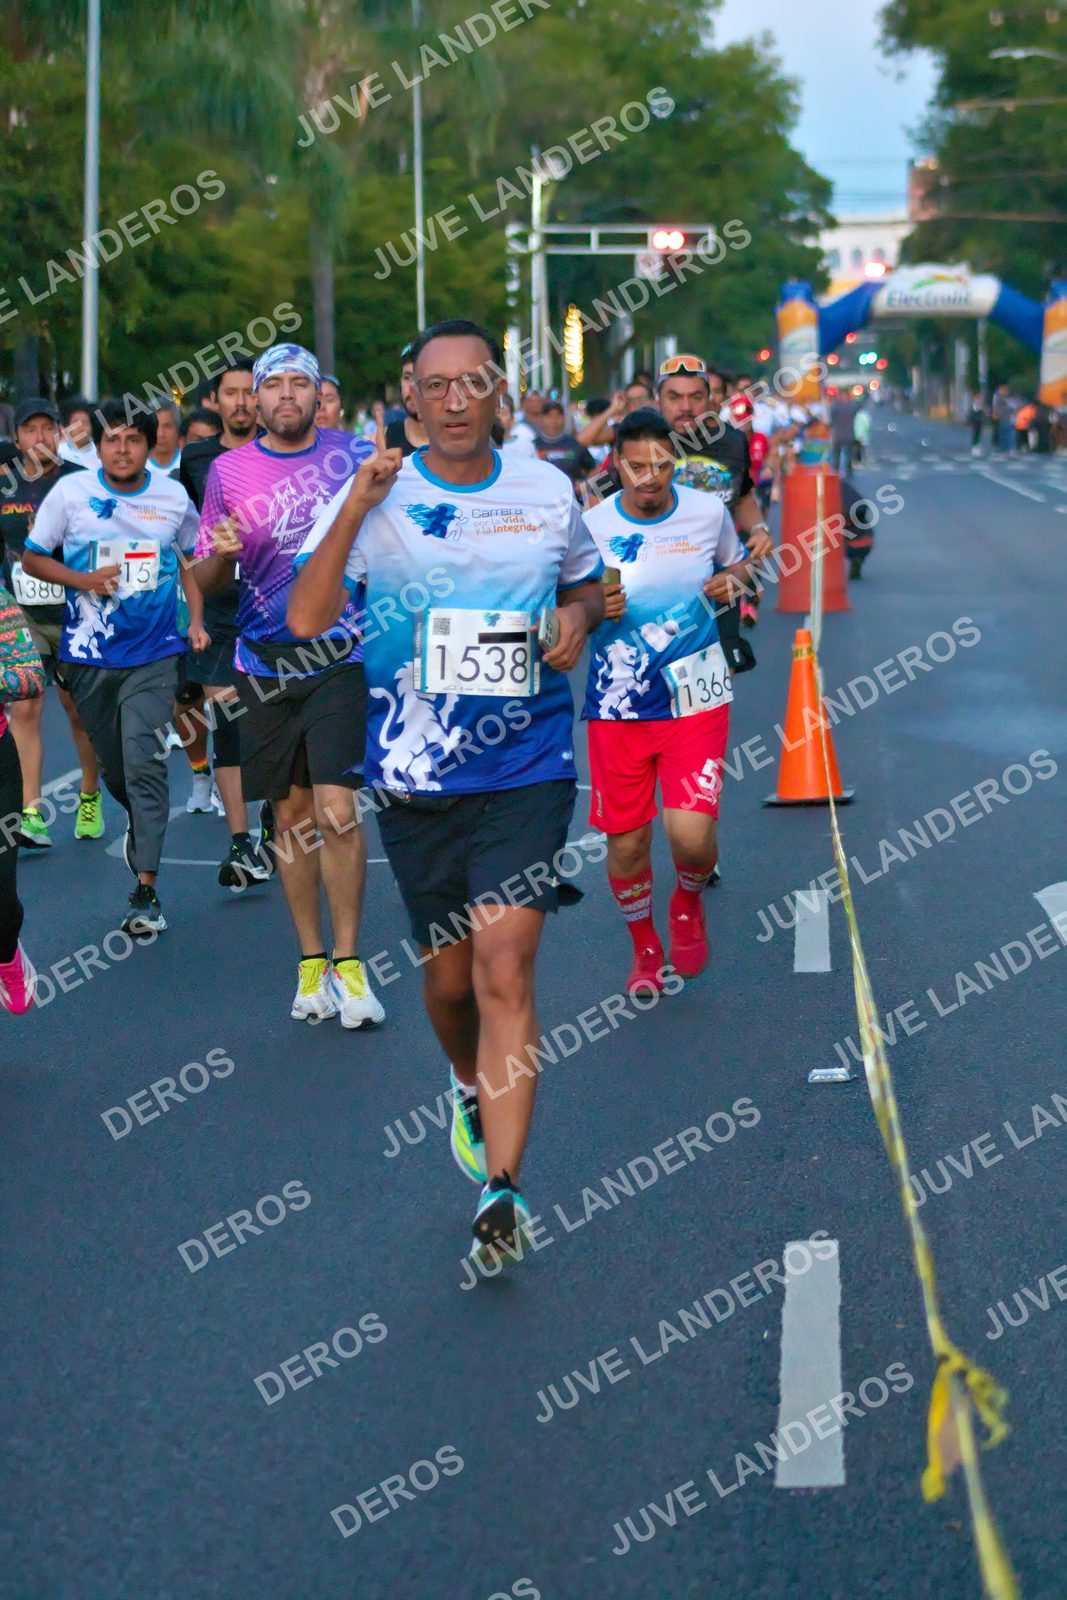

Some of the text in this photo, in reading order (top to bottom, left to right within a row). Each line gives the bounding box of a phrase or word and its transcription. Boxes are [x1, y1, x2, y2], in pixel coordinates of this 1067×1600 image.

[1, 502, 33, 514] DNA
[471, 508, 522, 519] Carrera
[16, 580, 64, 599] 1380
[435, 644, 528, 684] 1538
[683, 666, 733, 708] 1366
